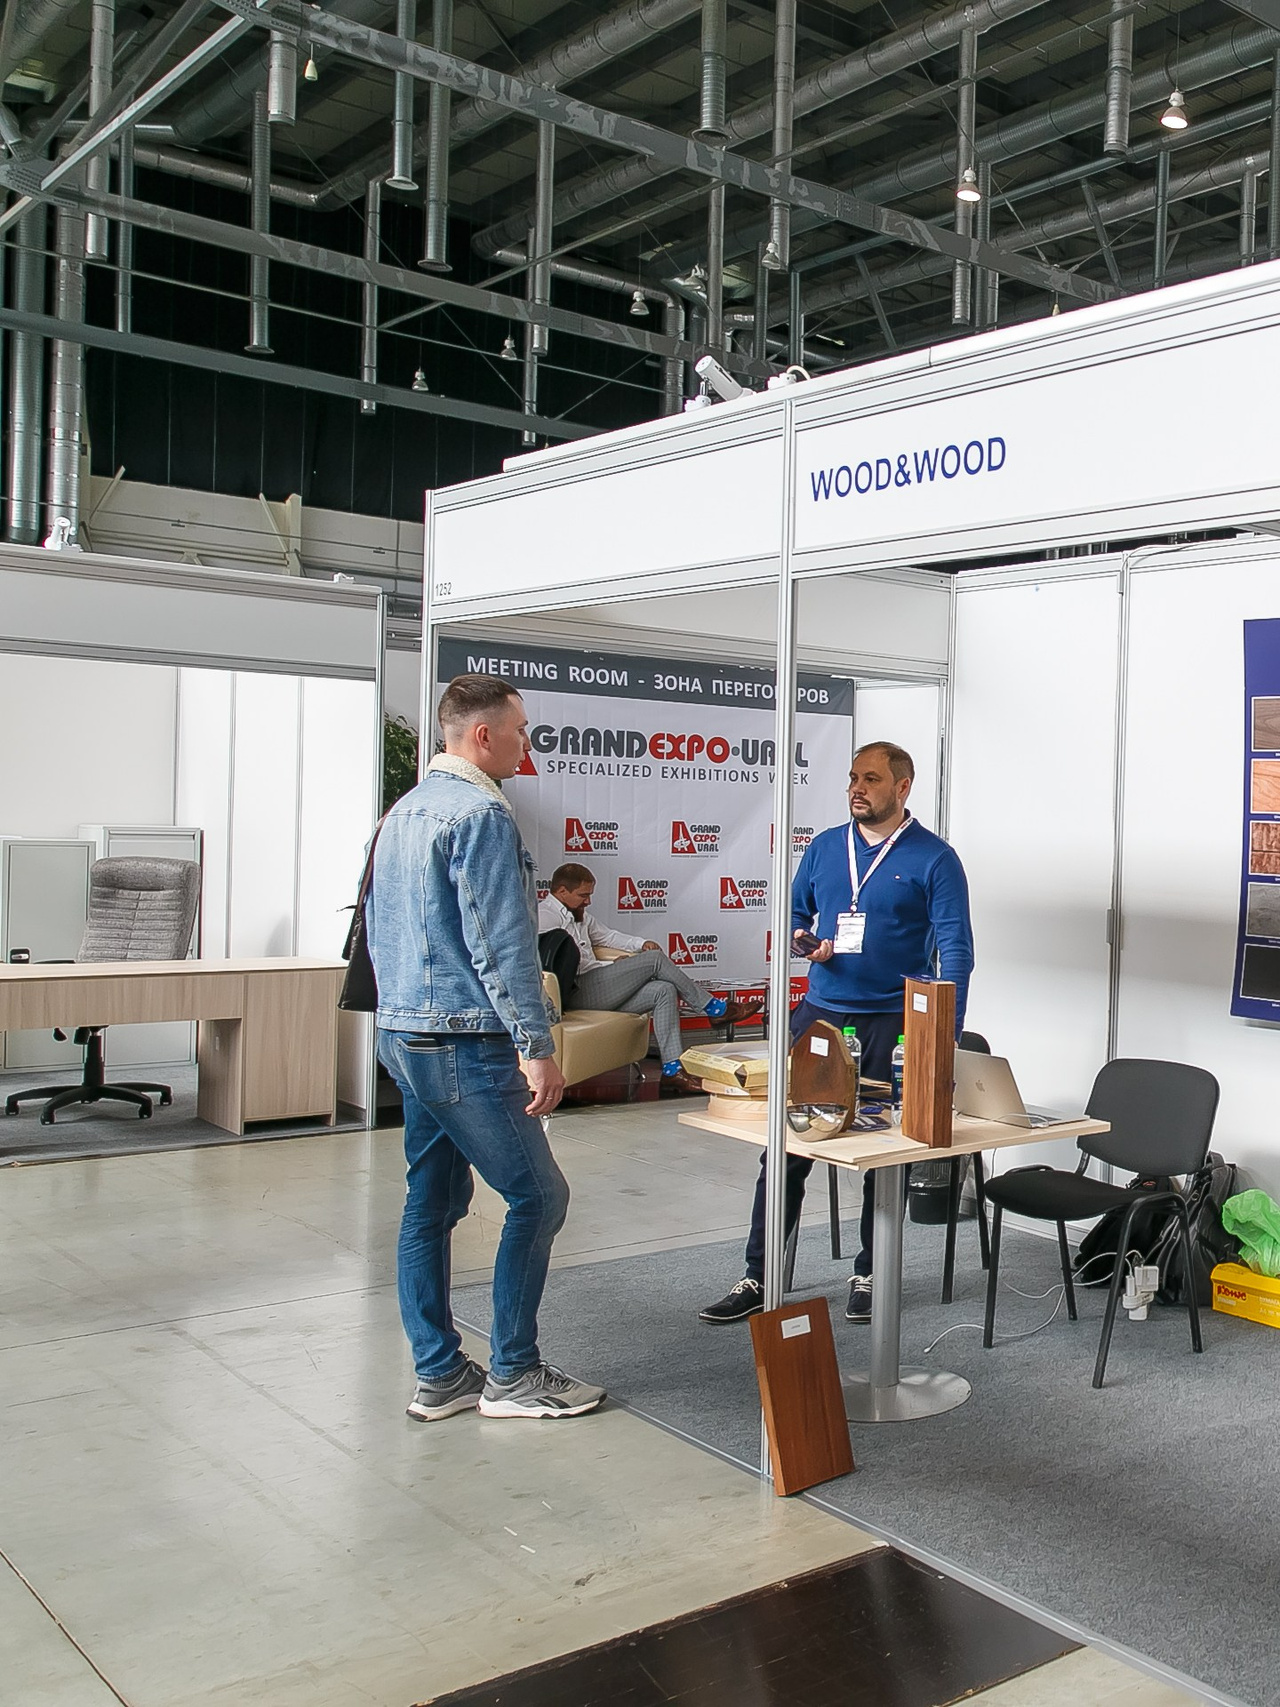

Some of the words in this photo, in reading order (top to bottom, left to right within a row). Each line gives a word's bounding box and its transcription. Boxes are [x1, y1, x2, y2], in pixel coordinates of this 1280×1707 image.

[810, 436, 1006, 502] WOOD&WOOD
[435, 582, 452, 597] 1252
[467, 656, 558, 680] MEETING
[569, 666, 628, 687] ROOM
[653, 674, 703, 694] ЗОНА
[712, 679, 829, 704] ПЕРЕГОРОВ
[546, 759, 652, 778] SPECIALIZED
[661, 764, 760, 784] EXHIBITIONS
[585, 822, 618, 831] GRAND
[690, 825, 720, 834] GRAND
[793, 826, 814, 835] RAND
[593, 841, 618, 850] URAL
[697, 843, 719, 852] URAL
[637, 880, 669, 889] GRAND
[738, 880, 768, 889] GRAND
[644, 898, 667, 908] URAL
[745, 898, 767, 907] URAL
[687, 935, 718, 944] GRAND
[694, 953, 718, 962] URAL
